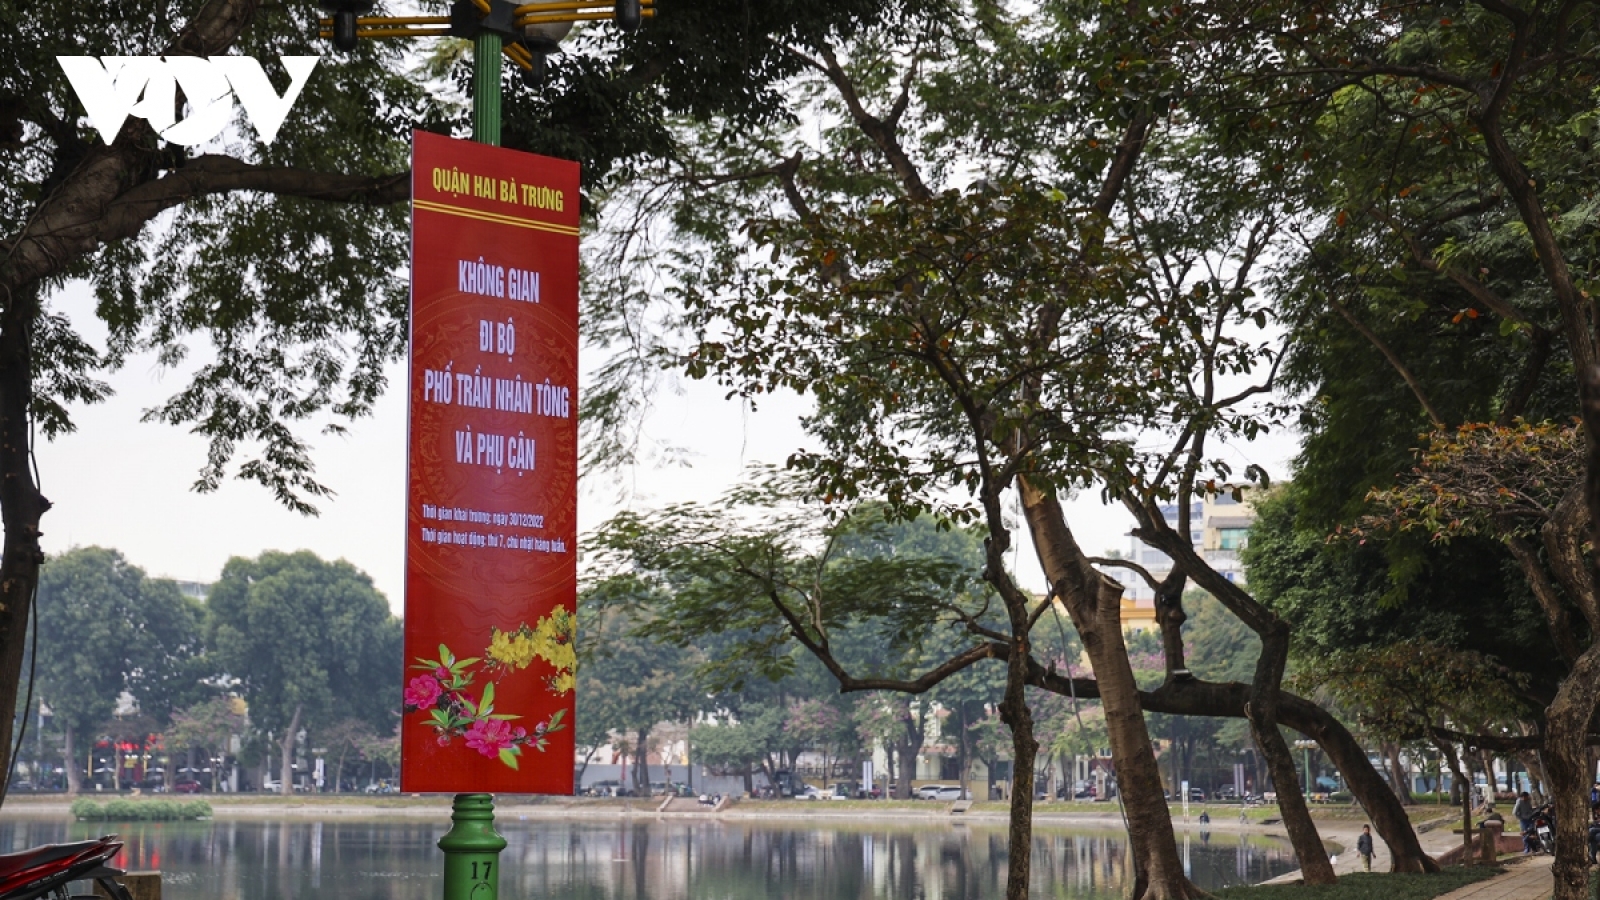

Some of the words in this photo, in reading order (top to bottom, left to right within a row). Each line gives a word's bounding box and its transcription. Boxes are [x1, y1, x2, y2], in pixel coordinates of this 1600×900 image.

[432, 166, 470, 198] QUẬN
[474, 174, 496, 200] HAI
[500, 177, 518, 204] BÀ
[521, 183, 564, 212] TRƯNG
[459, 256, 504, 298] KHÔNG
[508, 267, 540, 303] GIAN
[479, 319, 493, 353] ĐI
[497, 316, 515, 363] BỘ
[424, 360, 453, 405] PHỐ
[456, 364, 491, 409] TRẦN
[495, 374, 533, 414] NHÂN
[536, 377, 569, 418] TÔNG
[455, 424, 473, 464] VÀ
[477, 432, 504, 474] PHỤ
[508, 430, 535, 477] CẬN
[438, 506, 453, 521] gian
[453, 507, 468, 521] khai
[437, 529, 452, 545] gian
[471, 861, 493, 880] 17
